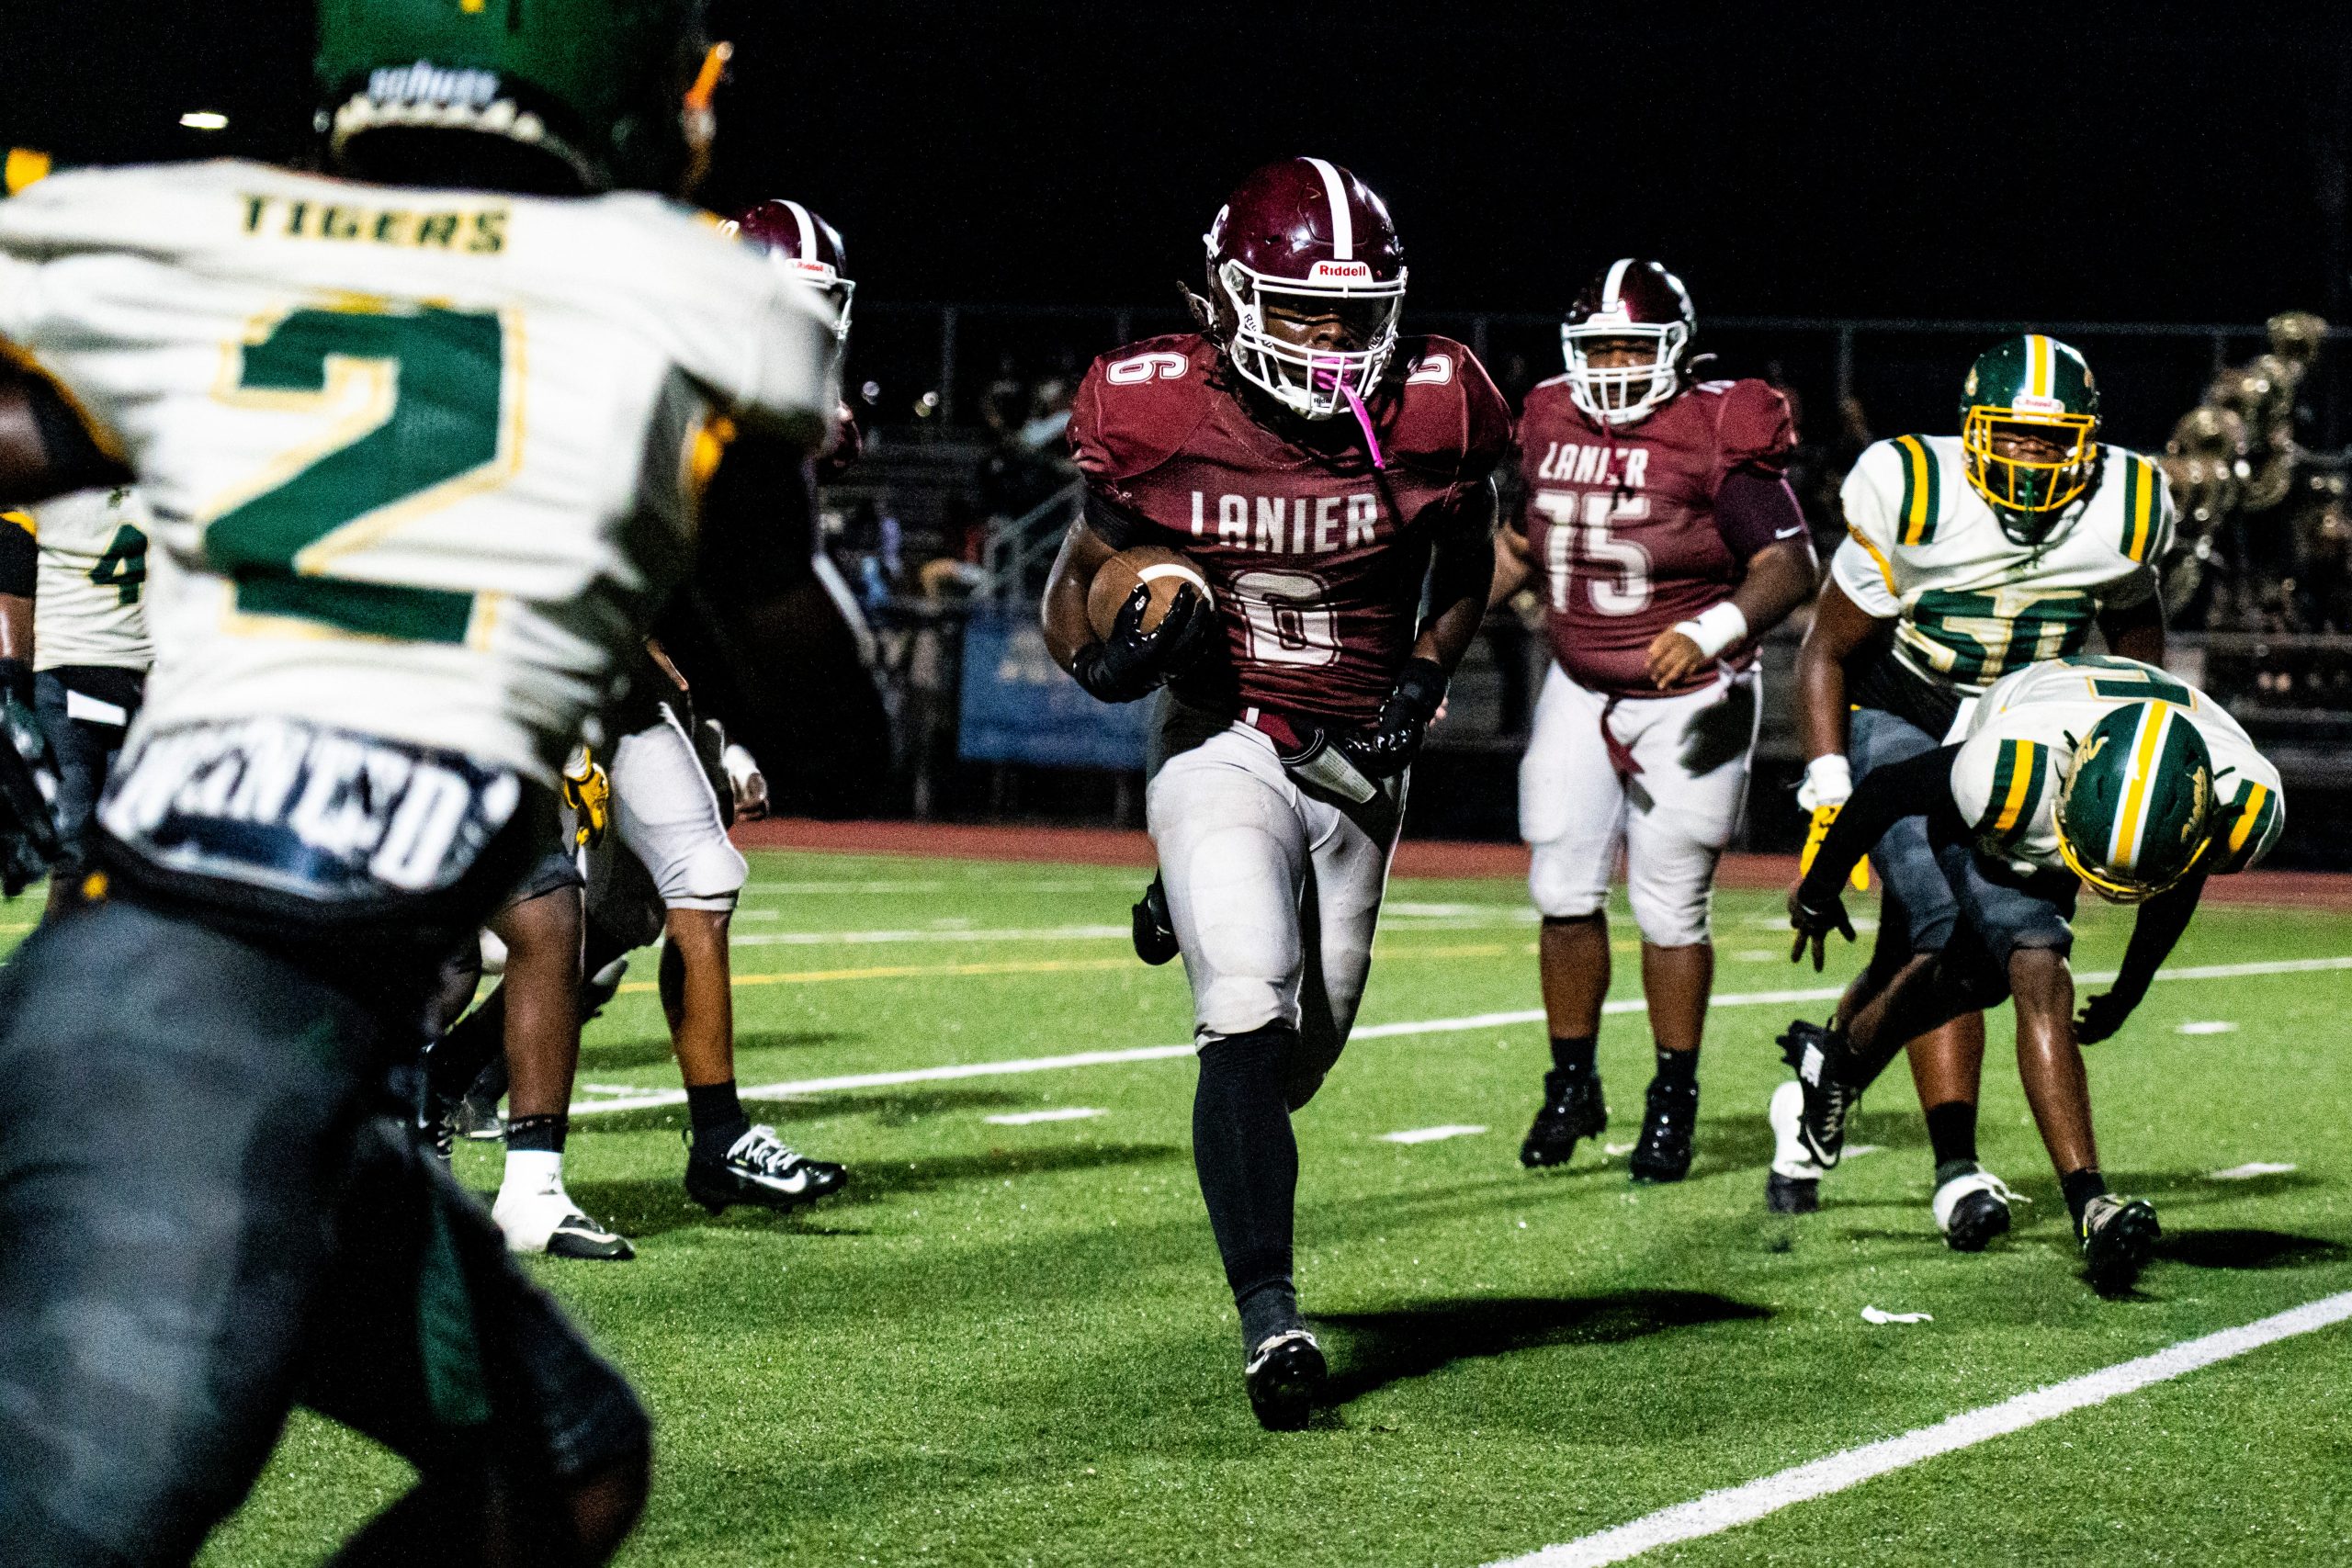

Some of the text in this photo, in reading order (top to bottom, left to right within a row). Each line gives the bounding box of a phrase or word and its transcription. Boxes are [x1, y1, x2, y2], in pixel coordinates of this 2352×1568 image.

[240, 192, 511, 254] TIGERS
[1319, 265, 1366, 276] Riddell
[204, 292, 527, 649] 2
[1534, 489, 1652, 618] 75
